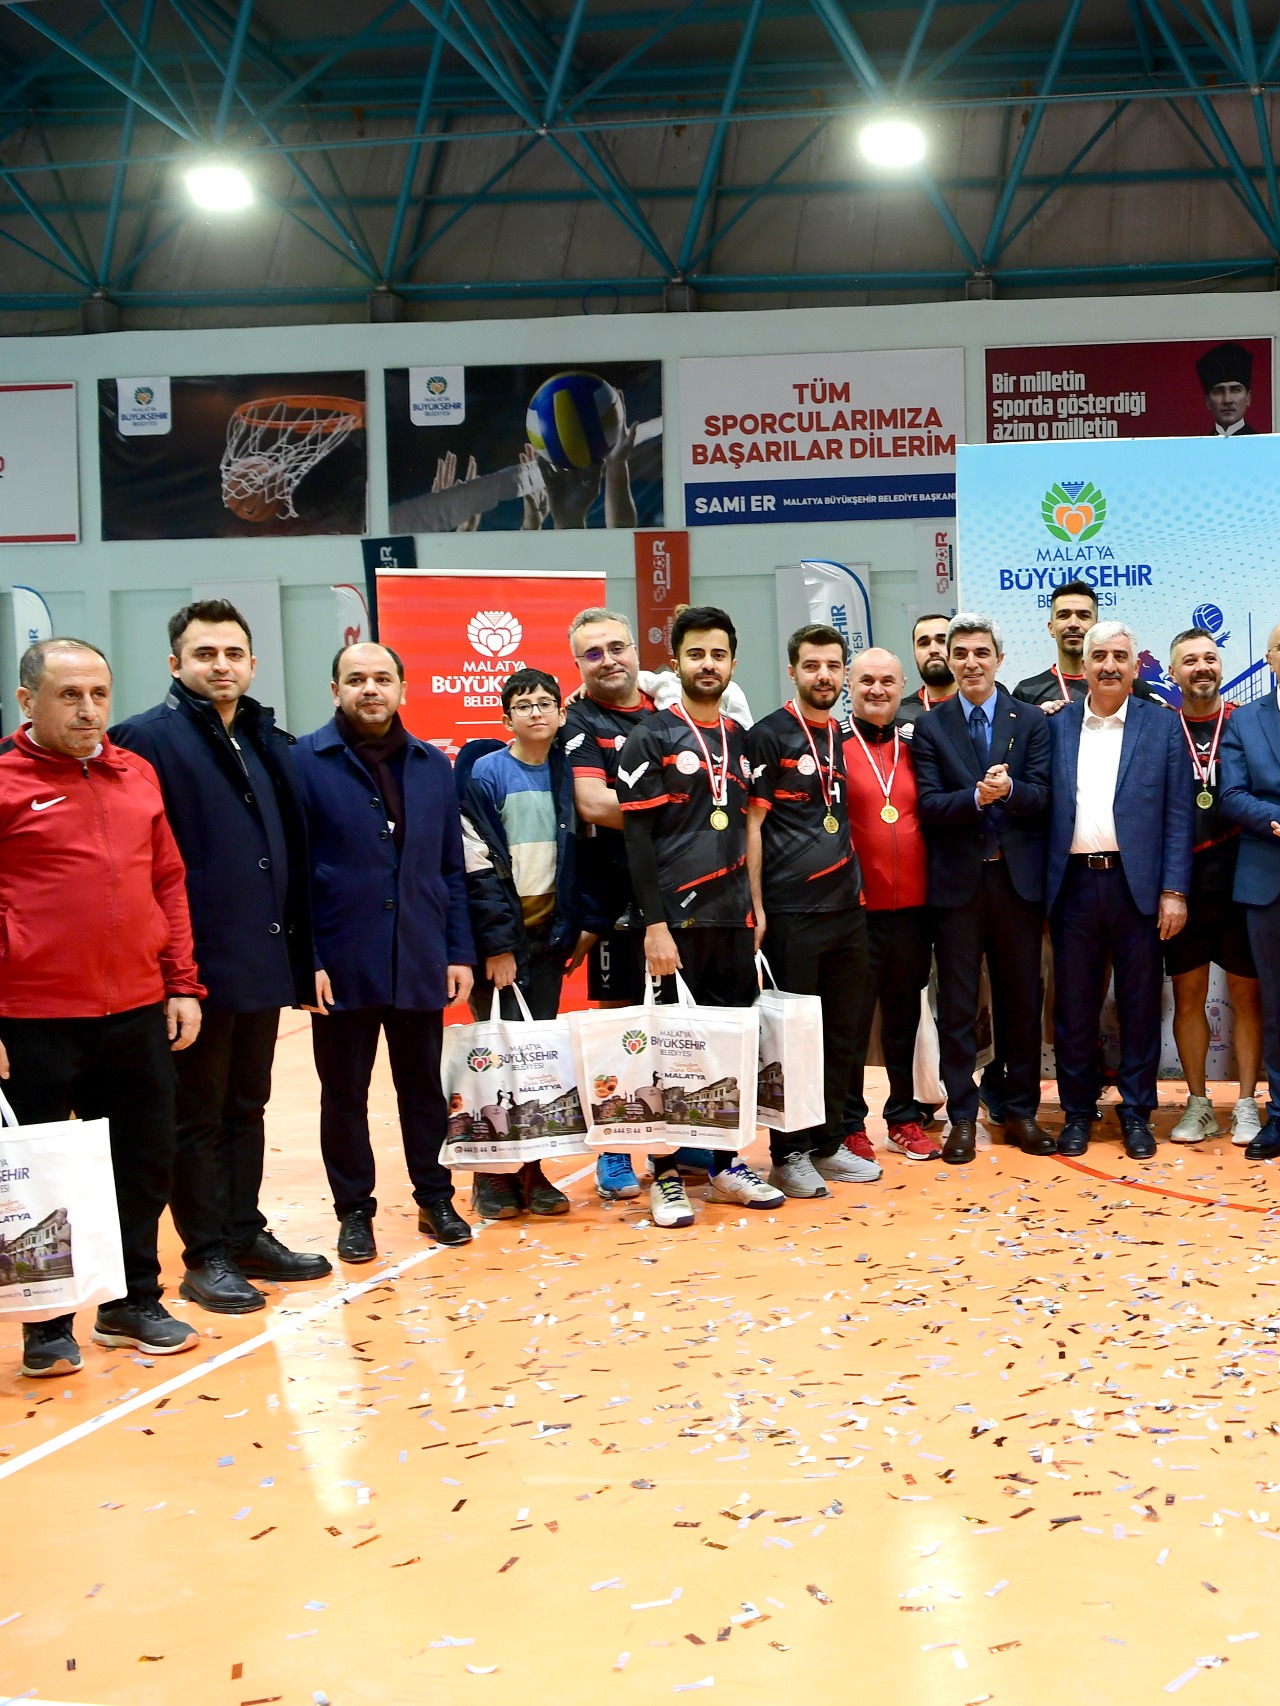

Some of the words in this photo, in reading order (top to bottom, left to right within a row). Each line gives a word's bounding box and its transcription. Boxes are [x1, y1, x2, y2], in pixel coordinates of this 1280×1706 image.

[792, 378, 850, 404] TÜM
[992, 372, 1017, 393] Bir
[1020, 370, 1086, 392] milletin
[992, 395, 1053, 420] sporda
[1057, 392, 1146, 418] gösterdiği
[704, 406, 943, 436] SPORCULARIMIZA
[993, 420, 1034, 440] azim
[1038, 422, 1048, 440] o
[1052, 417, 1118, 438] milletin
[692, 438, 843, 469] BAŞARILAR
[850, 430, 956, 459] DİLERİM
[751, 495, 776, 511] ER
[784, 498, 823, 506] MALATYA
[824, 494, 877, 505] BÜYÜKŞEHİR
[878, 493, 918, 502] BELEDİYE
[1036, 546, 1115, 562] MALATYA
[463, 660, 527, 672] MALATYA
[664, 1072, 706, 1080] MALATYA
[519, 1084, 562, 1093] MALATYA
